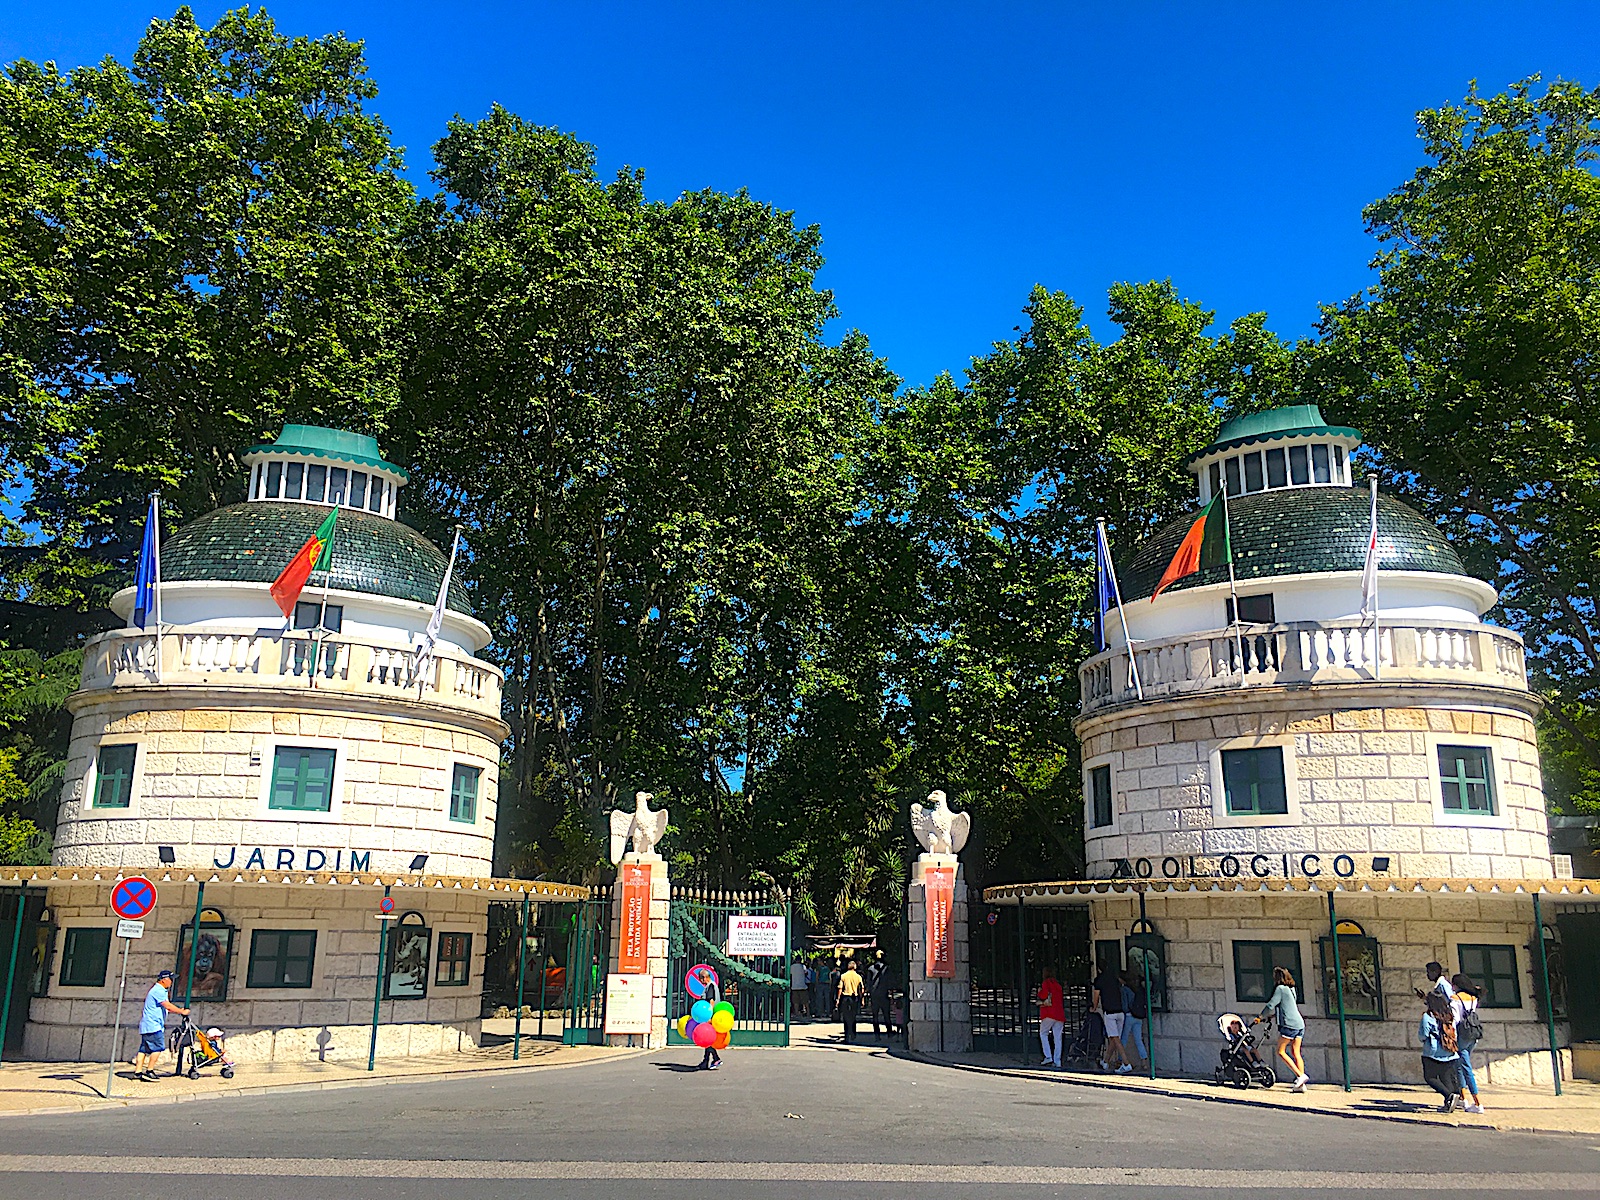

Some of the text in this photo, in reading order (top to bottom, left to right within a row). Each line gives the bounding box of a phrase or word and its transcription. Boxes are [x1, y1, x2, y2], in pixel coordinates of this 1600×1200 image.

[214, 847, 370, 872] JARDIM
[628, 897, 636, 937] PROTEÇÃO
[737, 919, 778, 931] ATENÇÃO
[932, 900, 940, 941] PROTEÇÃO
[634, 946, 640, 958] DA
[941, 950, 948, 962] DA
